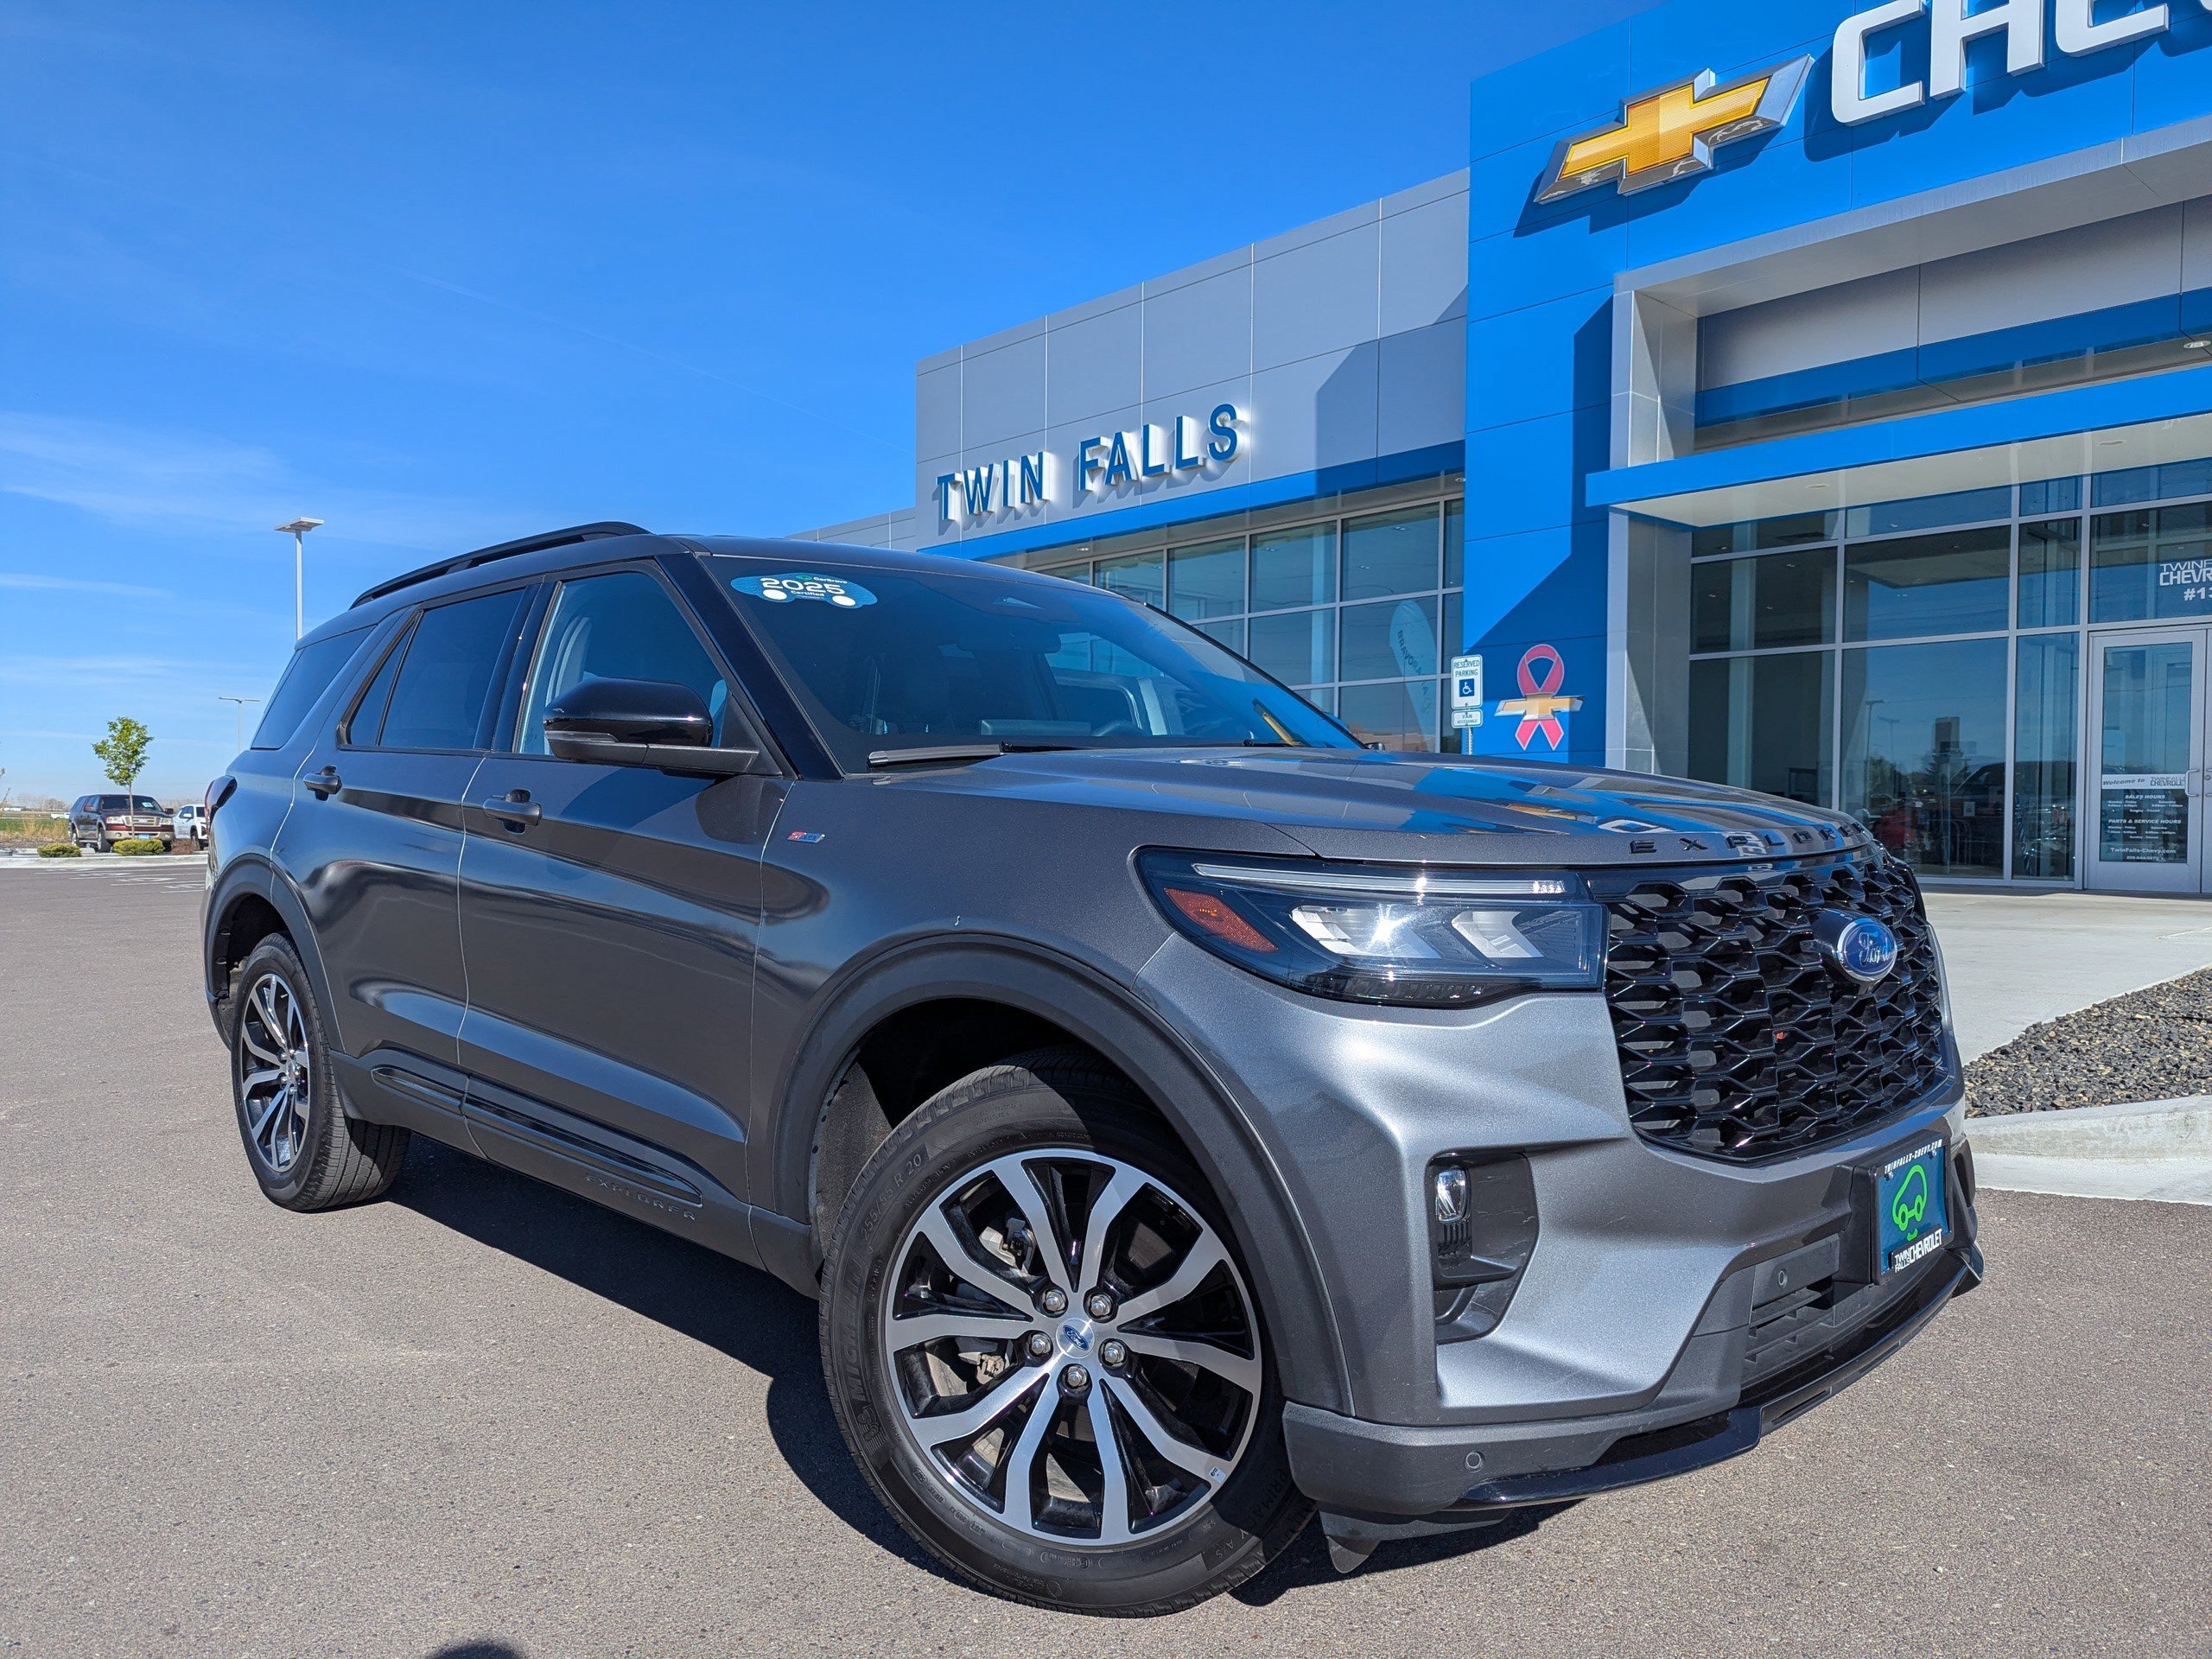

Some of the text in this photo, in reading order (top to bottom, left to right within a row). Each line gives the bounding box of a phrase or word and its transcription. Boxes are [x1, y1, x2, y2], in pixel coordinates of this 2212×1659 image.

[1832, 0, 2212, 126] CHE
[936, 403, 1242, 521] TWIN FALLS
[760, 577, 846, 594] 2025
[2159, 568, 2212, 586] CHEVR
[1453, 659, 1480, 669] RESERVED
[1455, 669, 1478, 677] PARKING
[906, 1154, 922, 1176] 20
[586, 1173, 696, 1220] EXPLORER
[1909, 1228, 1942, 1264] CHEVROLET
[1894, 1249, 1910, 1264] TWIN
[1894, 1257, 1910, 1274] FALLS
